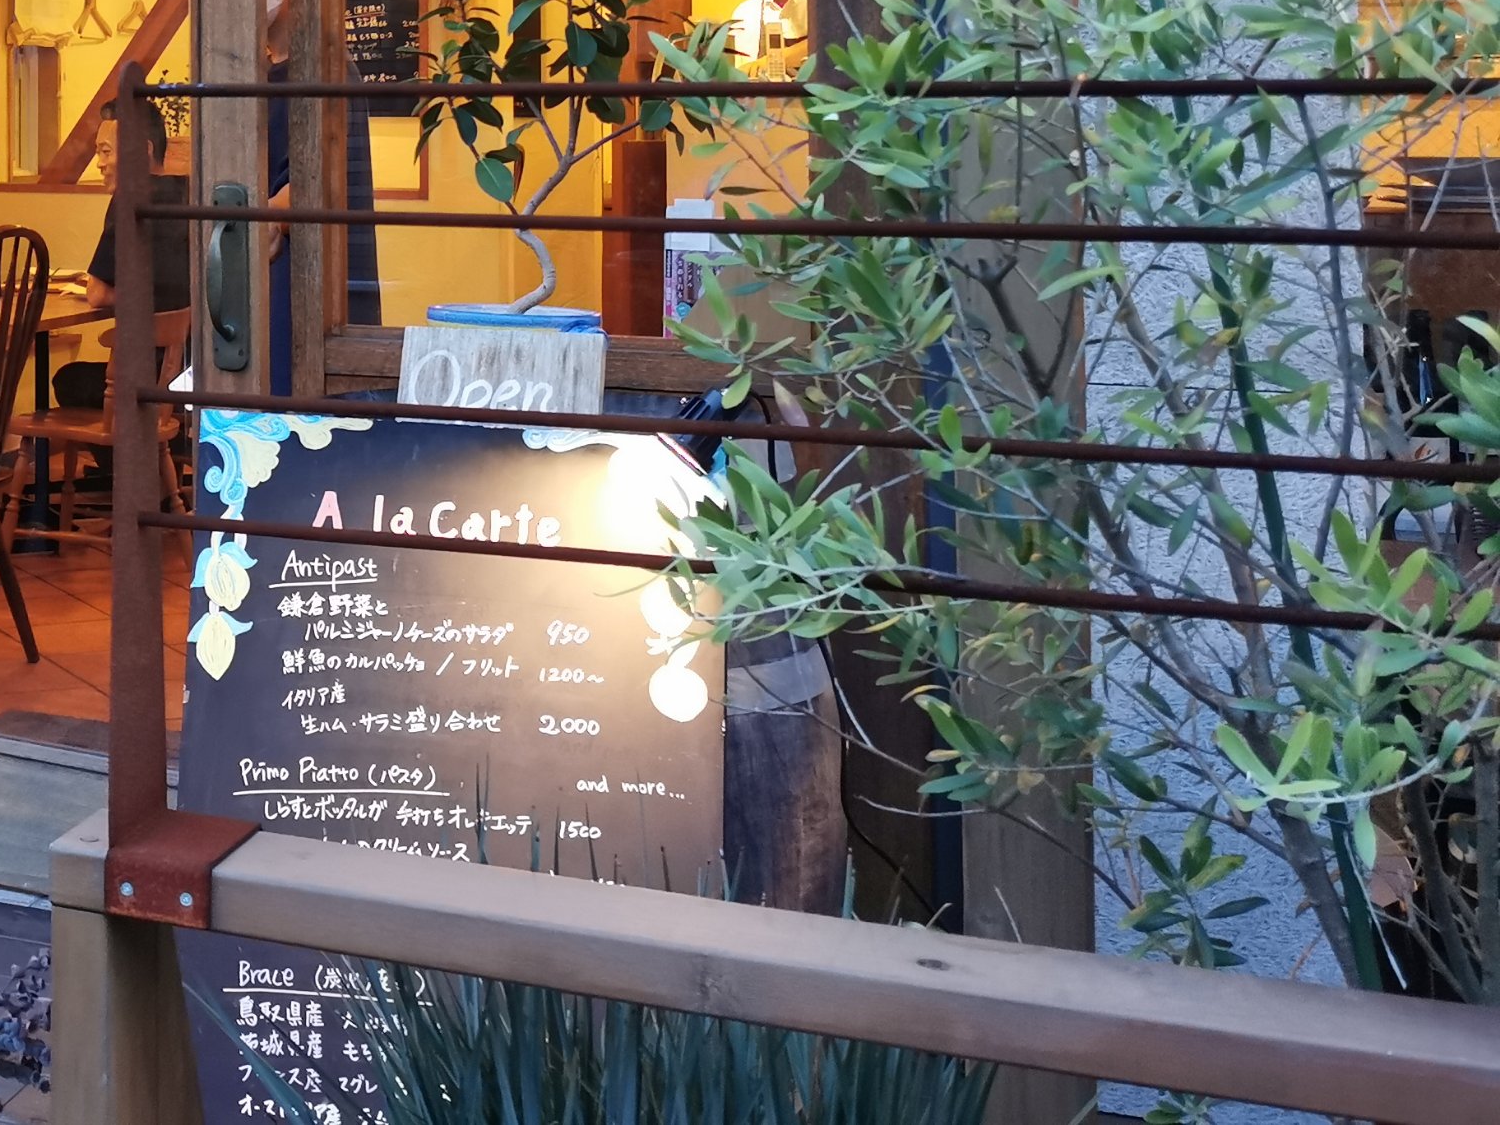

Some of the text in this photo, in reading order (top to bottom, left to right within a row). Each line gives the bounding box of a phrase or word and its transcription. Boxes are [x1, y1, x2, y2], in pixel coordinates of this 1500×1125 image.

[312, 491, 562, 547] A la Carte
[281, 549, 378, 592] Antipast
[277, 591, 389, 618] 鎌倉野菜と
[546, 620, 590, 645] 950
[462, 655, 519, 678] フリット
[282, 678, 347, 710] イタリア産
[539, 714, 600, 735] 2000
[240, 758, 290, 787] Primo
[299, 756, 359, 784] Piatto
[576, 775, 609, 793] and
[264, 794, 388, 822] しらすとボッタルガ
[239, 960, 294, 986] Brace
[236, 995, 324, 1026] 鳥取県産
